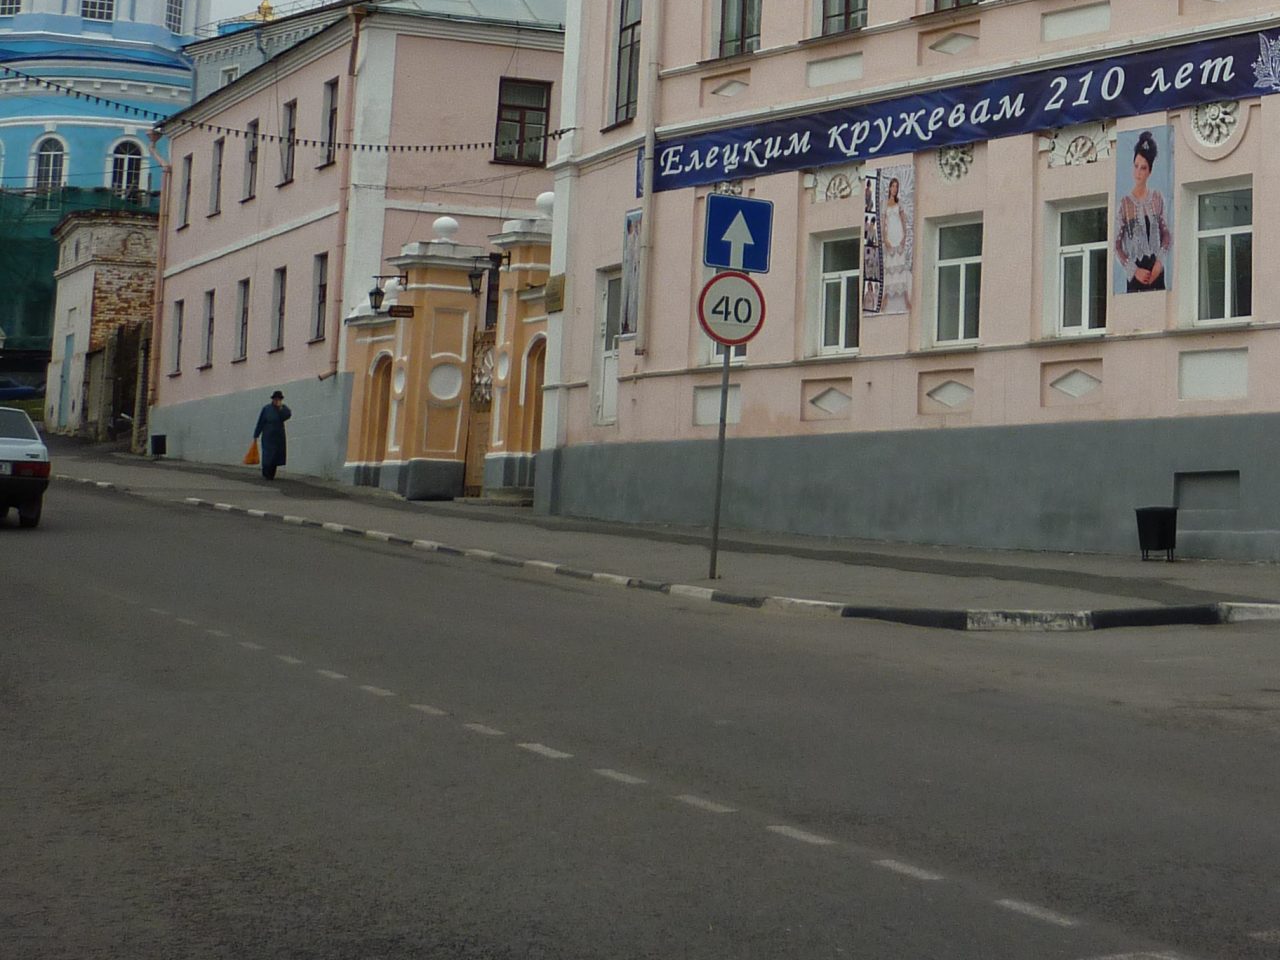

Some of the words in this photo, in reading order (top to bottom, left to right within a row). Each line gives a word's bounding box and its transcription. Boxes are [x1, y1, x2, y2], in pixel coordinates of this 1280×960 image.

[660, 130, 811, 176] Елецким
[828, 92, 1025, 156] кружевам
[1044, 66, 1126, 111] 210
[1143, 55, 1236, 95] лет
[711, 295, 752, 324] 40
